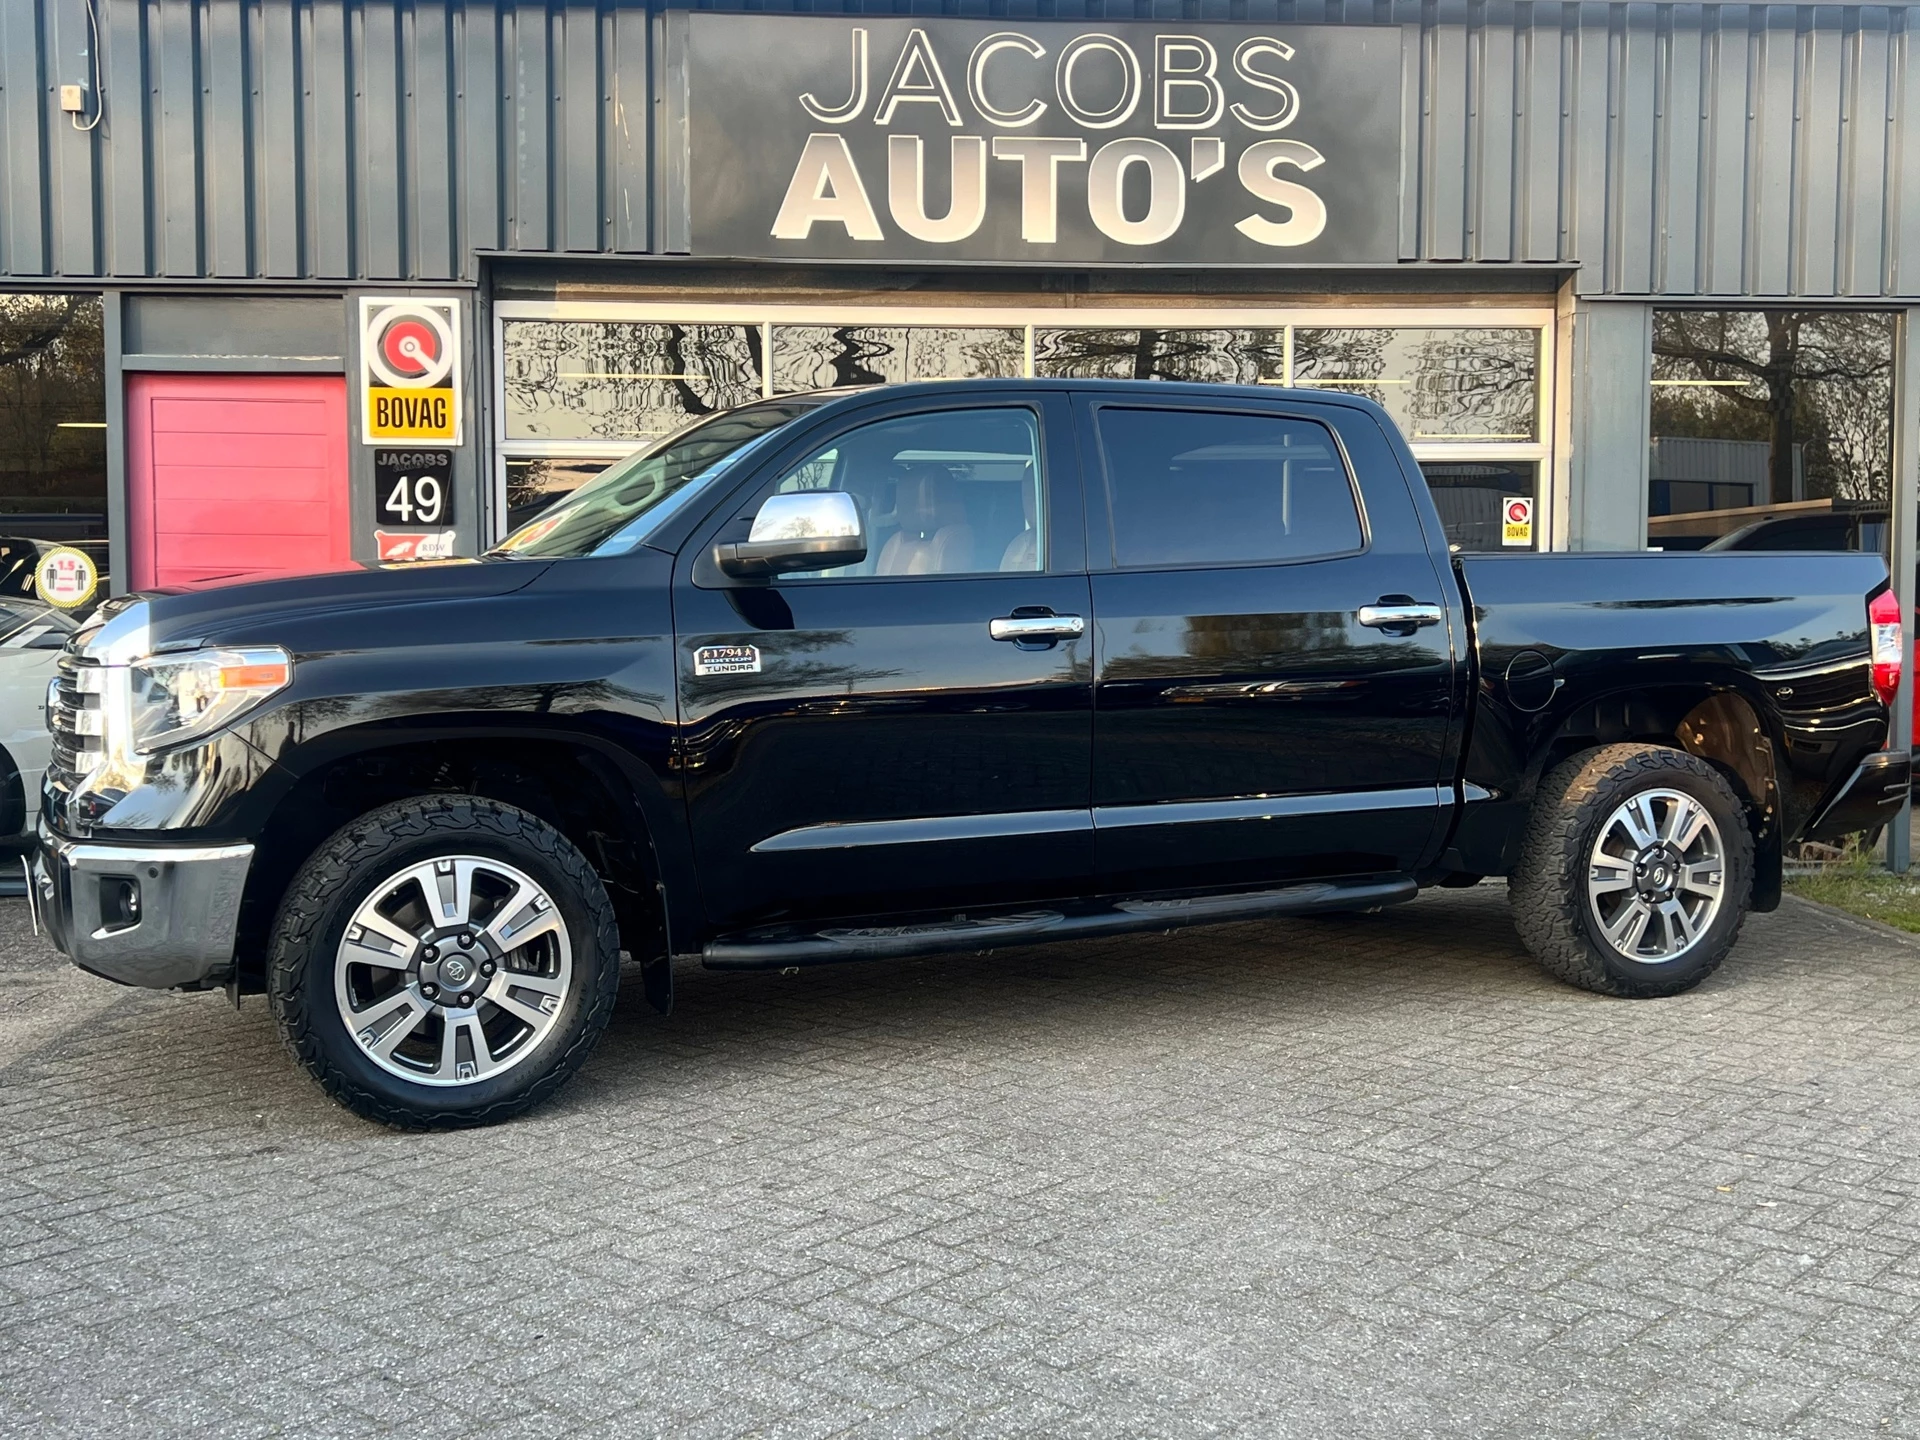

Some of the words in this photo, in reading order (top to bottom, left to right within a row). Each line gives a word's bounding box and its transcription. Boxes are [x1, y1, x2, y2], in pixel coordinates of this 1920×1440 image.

[799, 28, 1300, 132] JACOBS
[770, 132, 1327, 247] AUTO'S
[377, 396, 447, 428] BOVAG
[377, 453, 448, 466] JACOBS
[385, 476, 442, 522] 49
[1507, 527, 1528, 537] BOVAG
[422, 544, 446, 552] RDW
[712, 648, 743, 658] 1794
[705, 664, 753, 672] TUNDRA
